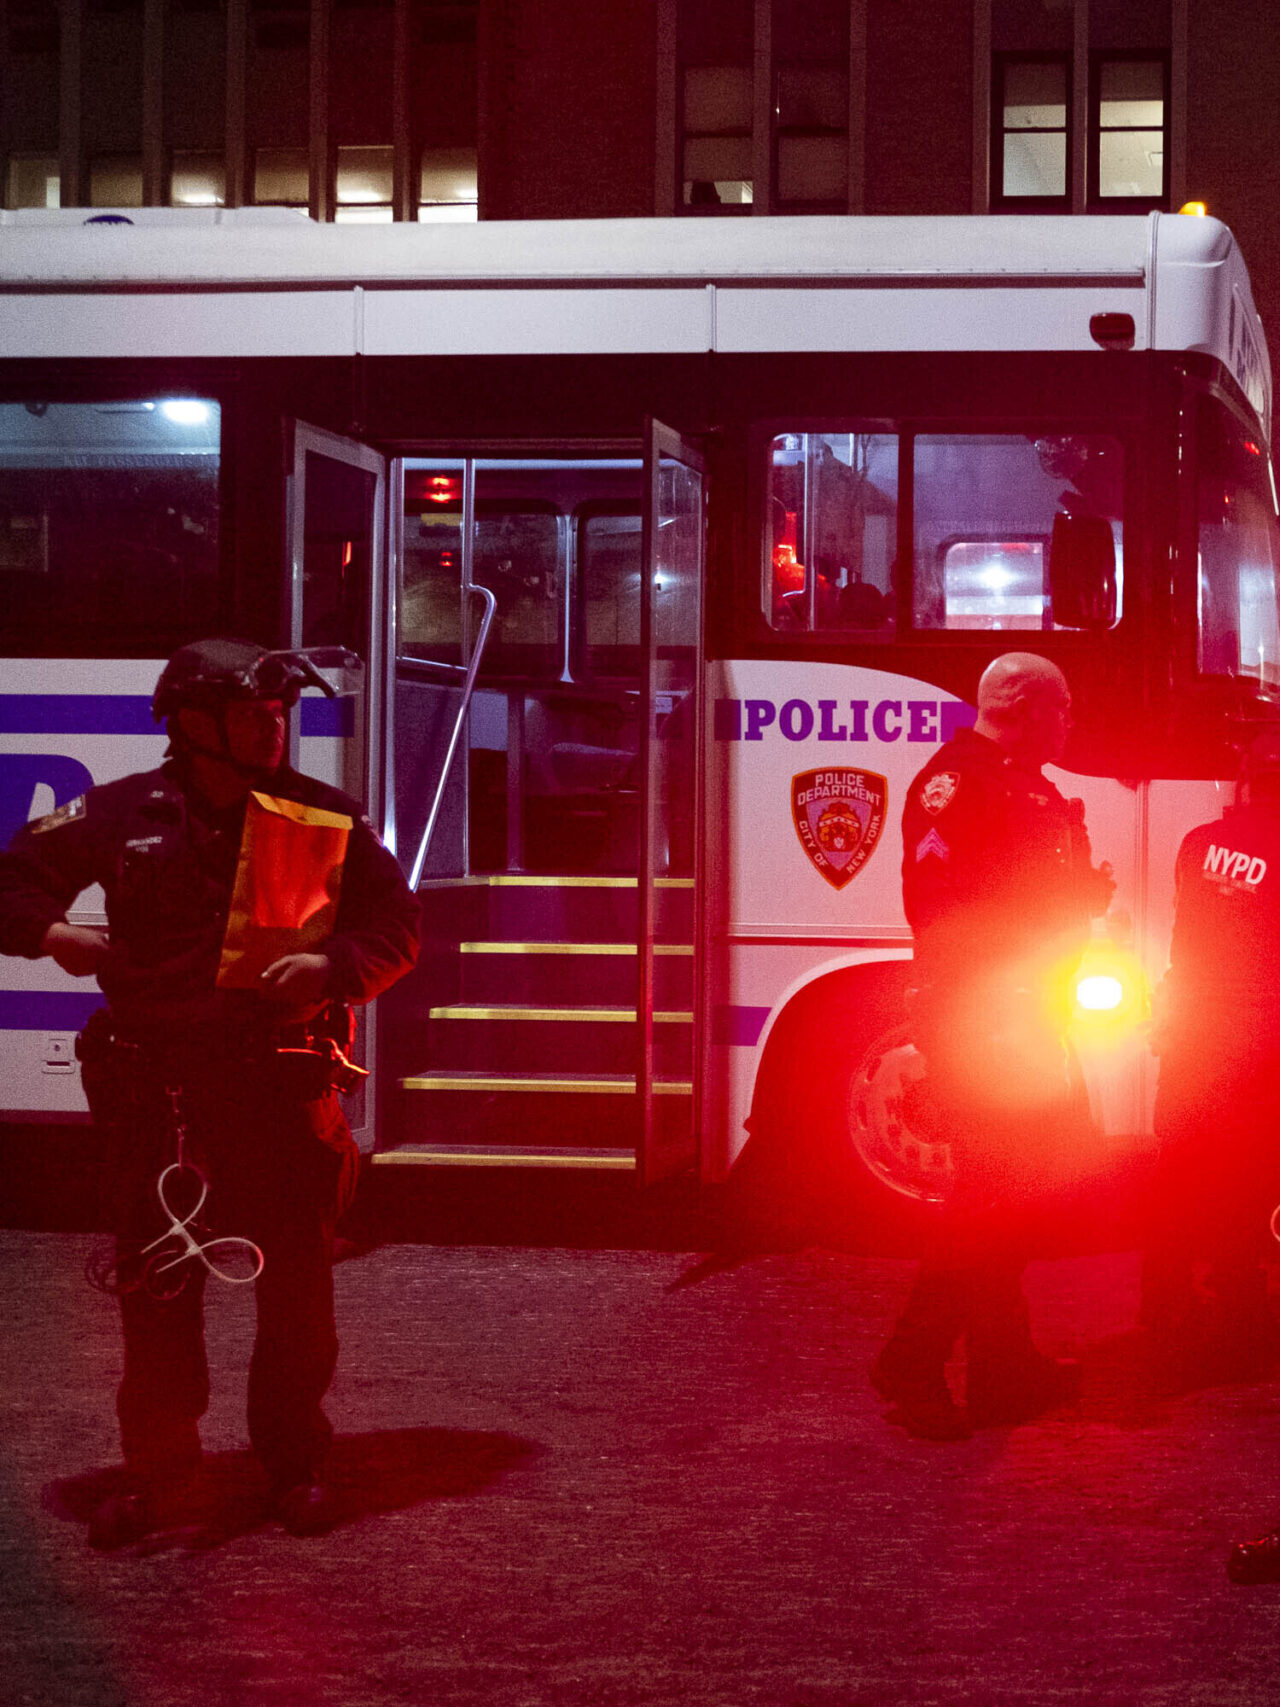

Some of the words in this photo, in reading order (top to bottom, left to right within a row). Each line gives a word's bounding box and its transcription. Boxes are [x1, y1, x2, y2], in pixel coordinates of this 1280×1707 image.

[744, 698, 938, 743] POLICE
[797, 784, 880, 806] DEPARTMENT
[815, 772, 865, 788] POLICE
[799, 820, 817, 849] CITY
[813, 852, 829, 868] OF
[845, 849, 867, 874] NEW
[864, 814, 881, 846] YORK
[1203, 844, 1267, 885] NYPD
